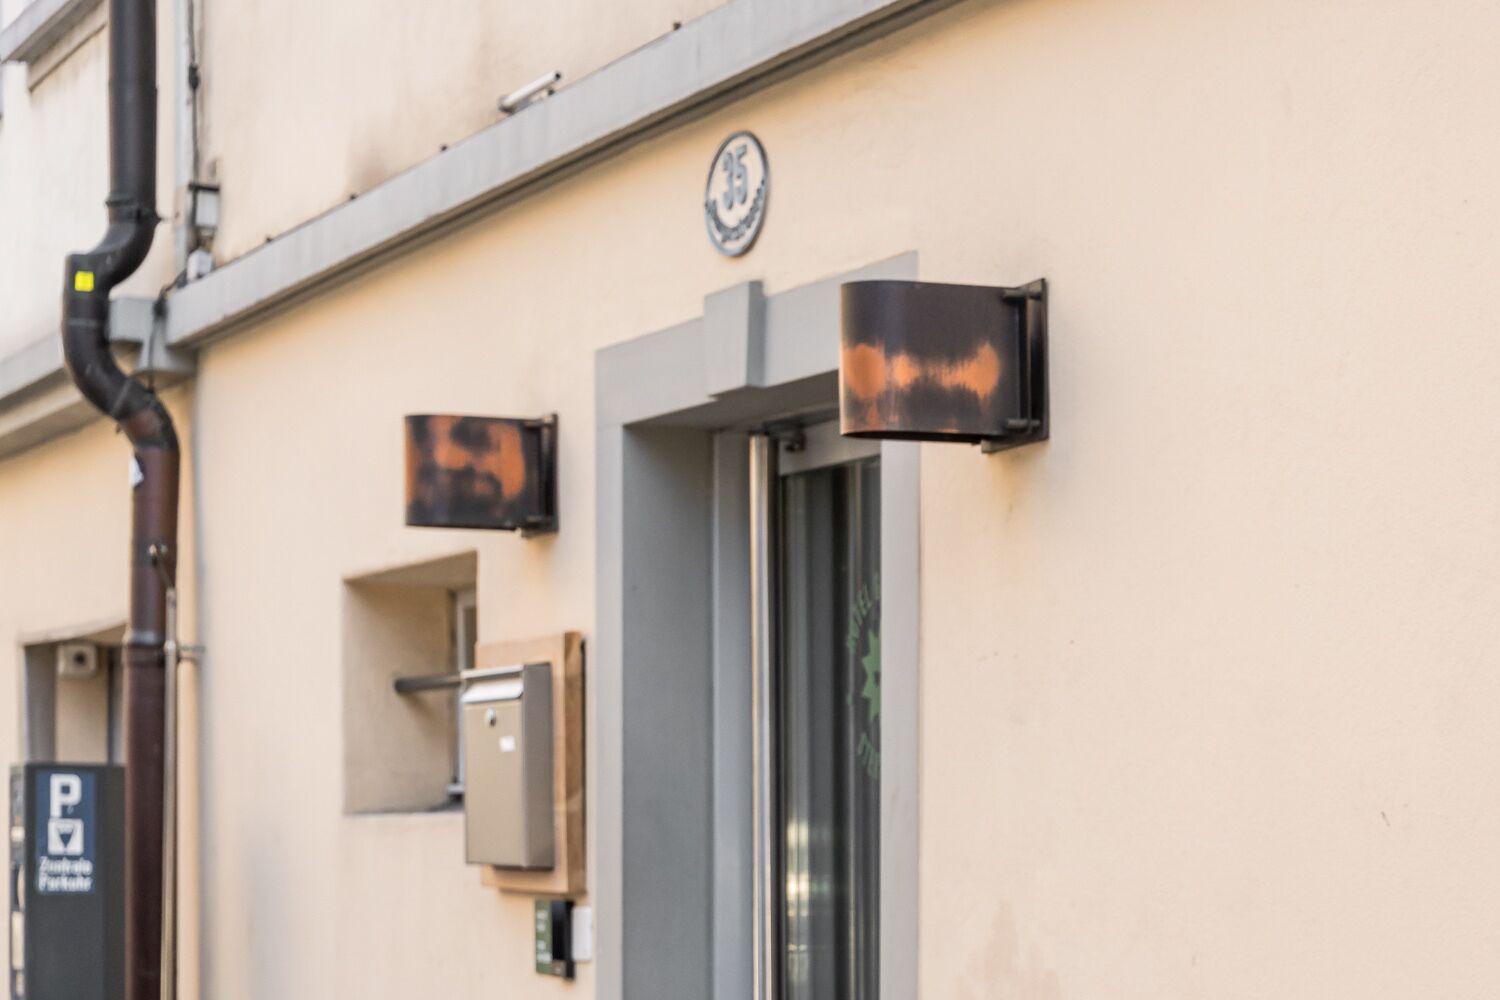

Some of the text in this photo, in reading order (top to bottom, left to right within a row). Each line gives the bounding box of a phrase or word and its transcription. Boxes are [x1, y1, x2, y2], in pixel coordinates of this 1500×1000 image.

[723, 144, 749, 211] 35
[49, 773, 82, 819] P
[38, 873, 93, 892] Parkuhr
